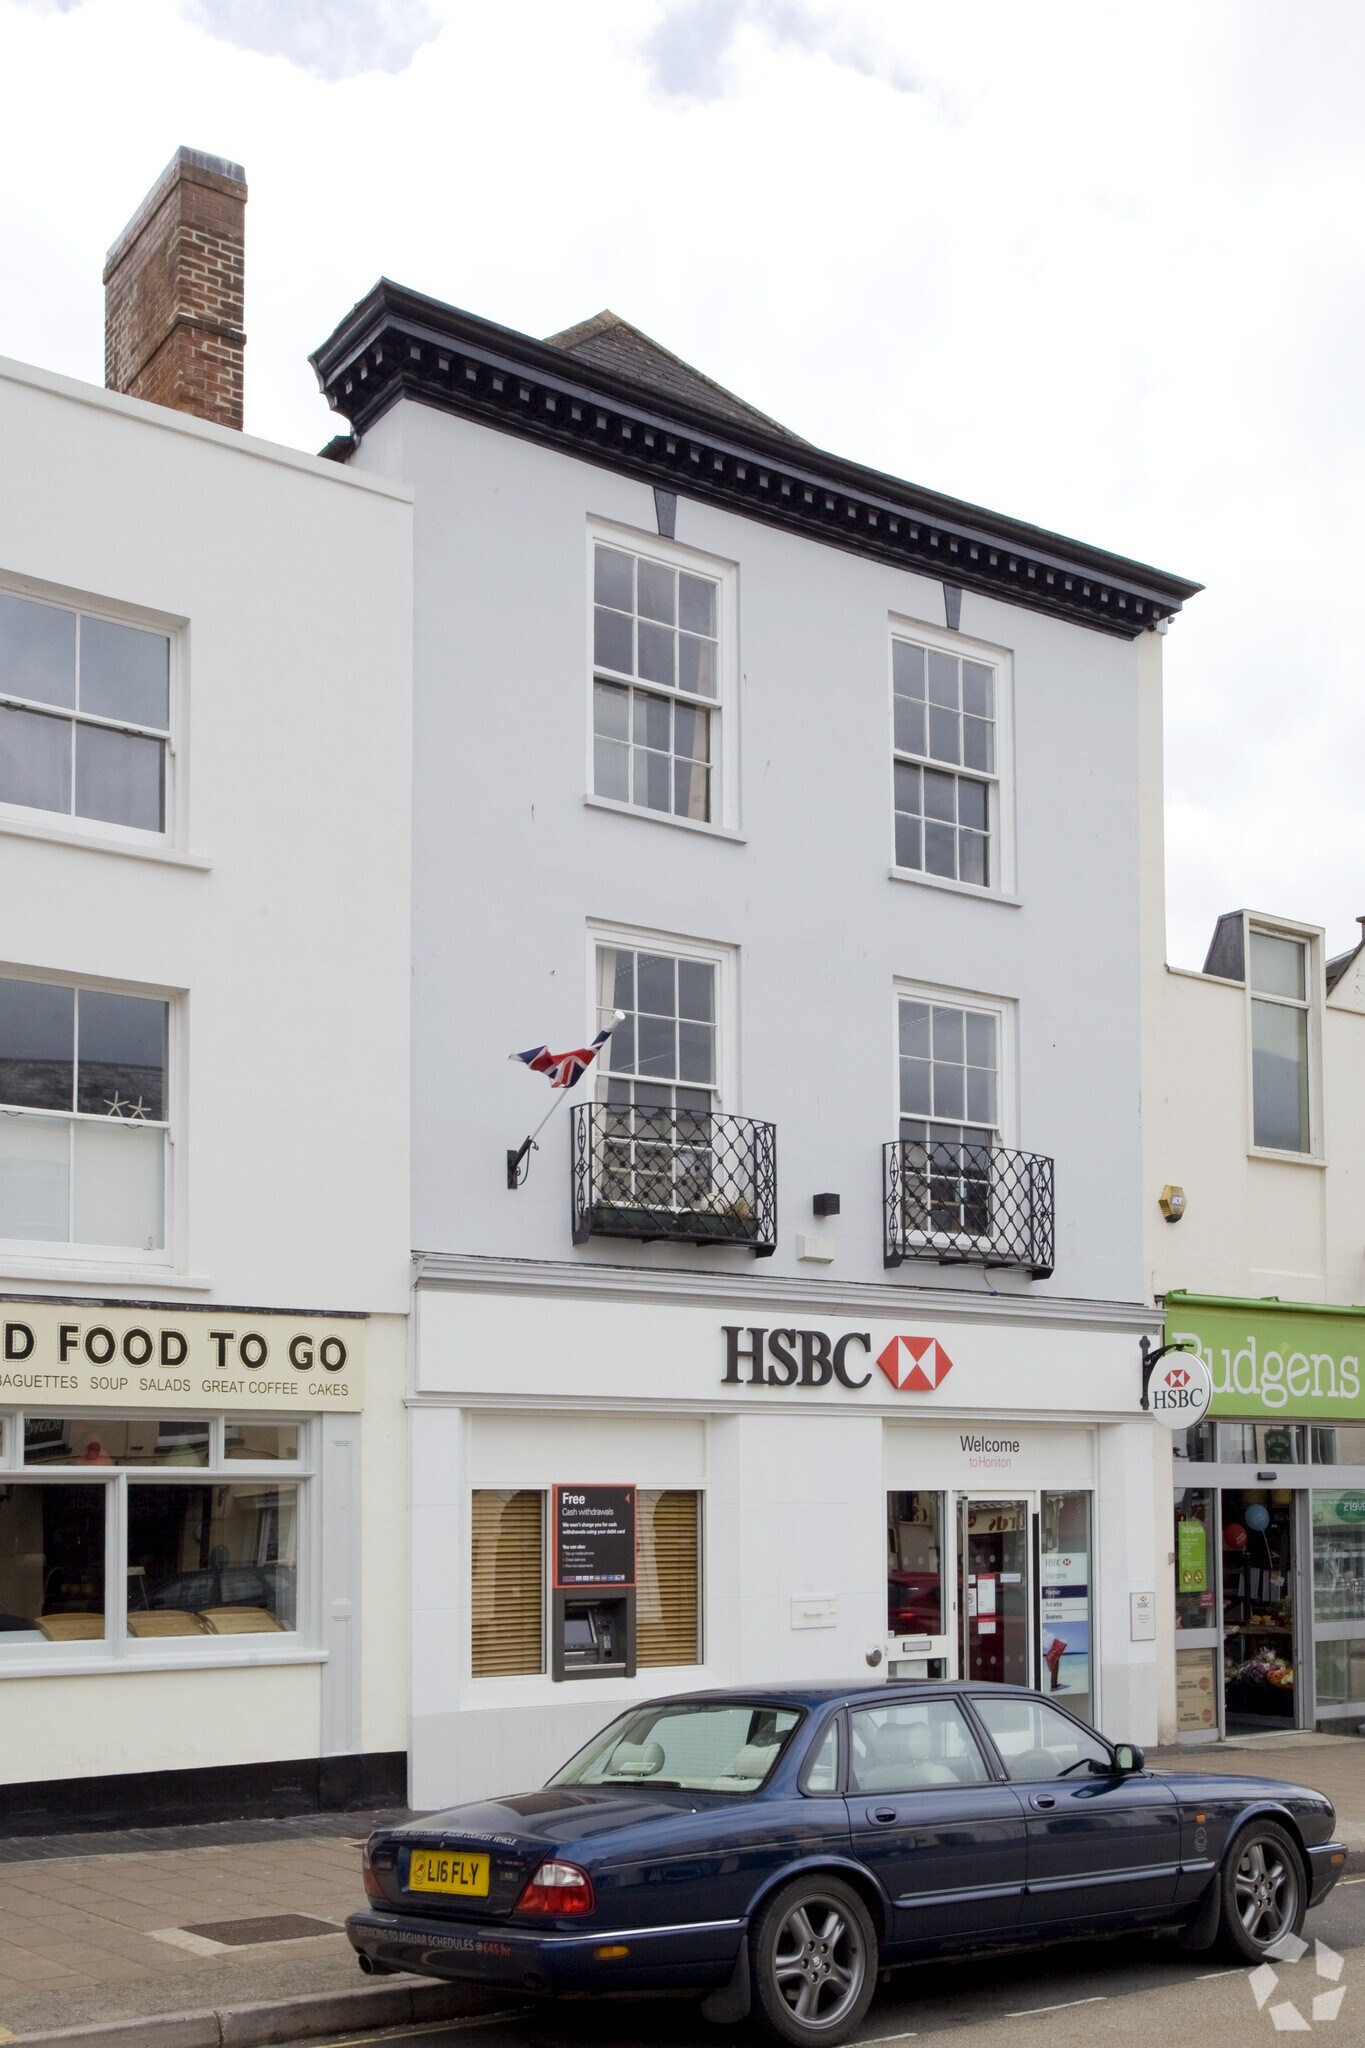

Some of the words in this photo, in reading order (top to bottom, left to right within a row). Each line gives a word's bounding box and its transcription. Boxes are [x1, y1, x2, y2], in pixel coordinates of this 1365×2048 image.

[59, 1324, 188, 1367] FOOD
[209, 1331, 268, 1369] TO
[288, 1335, 347, 1372] GO
[720, 1326, 873, 1390] HSBC
[90, 1376, 128, 1390] SOUP
[139, 1378, 191, 1392] SALADS
[201, 1380, 245, 1393] GREAT
[248, 1381, 298, 1395] COFFEE
[308, 1383, 349, 1396] CAKES
[1153, 1388, 1203, 1410] HSBC
[960, 1435, 1020, 1452] Welcome
[969, 1457, 978, 1468] to
[979, 1456, 1011, 1468] Honiton
[562, 1492, 586, 1505] Free
[562, 1507, 578, 1516] Cash
[578, 1507, 614, 1516] withdrawals
[1045, 1558, 1062, 1567] HSBC
[463, 1832, 492, 1841] COURTESY
[492, 1835, 518, 1846] VEHICLE
[451, 1861, 479, 1886] FLY
[356, 1925, 389, 1940] SERVICING
[389, 1929, 398, 1941] TO
[399, 1931, 427, 1946] JAGUAR
[428, 1935, 475, 1951] SCHEDULES
